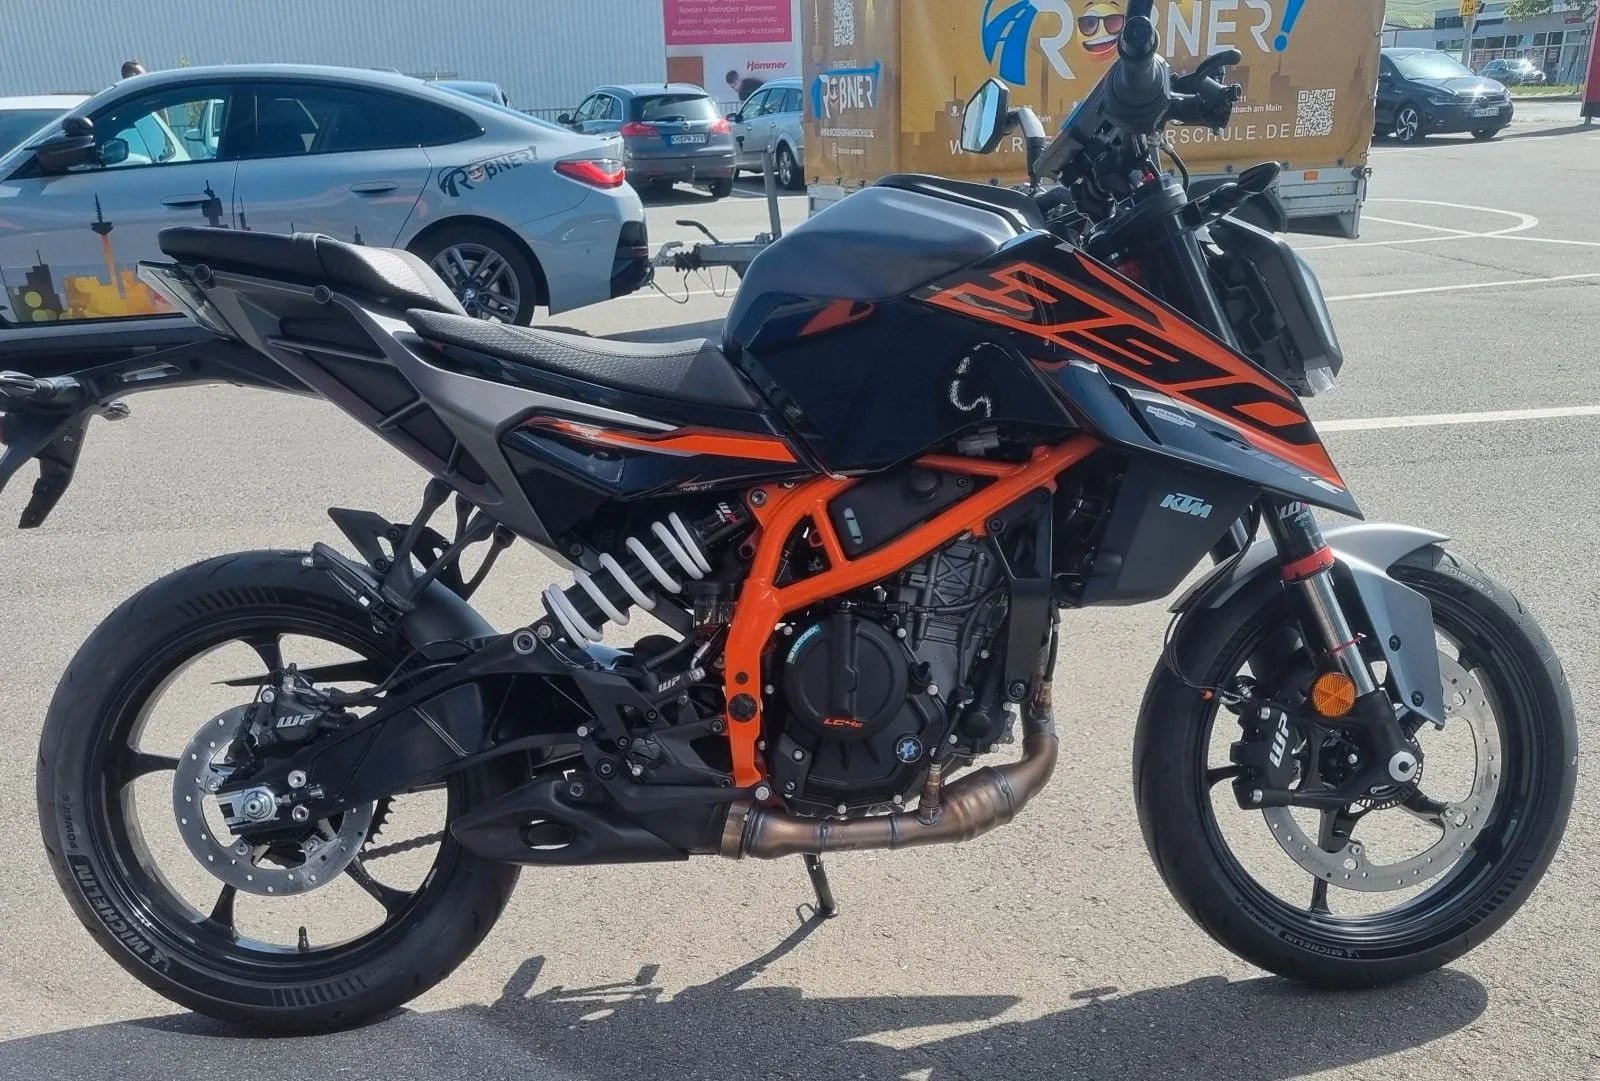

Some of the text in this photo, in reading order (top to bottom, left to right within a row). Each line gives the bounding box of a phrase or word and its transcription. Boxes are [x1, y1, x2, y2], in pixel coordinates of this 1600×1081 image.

[746, 61, 787, 71] Hammer
[1265, 103, 1282, 112] Main
[1159, 492, 1213, 519] KTM
[658, 675, 681, 693] WP
[275, 712, 316, 730] WP
[1268, 711, 1289, 769] WP
[63, 807, 79, 850] POWER
[75, 864, 151, 954] MICHELIN
[1284, 933, 1344, 956] MICHELIN
